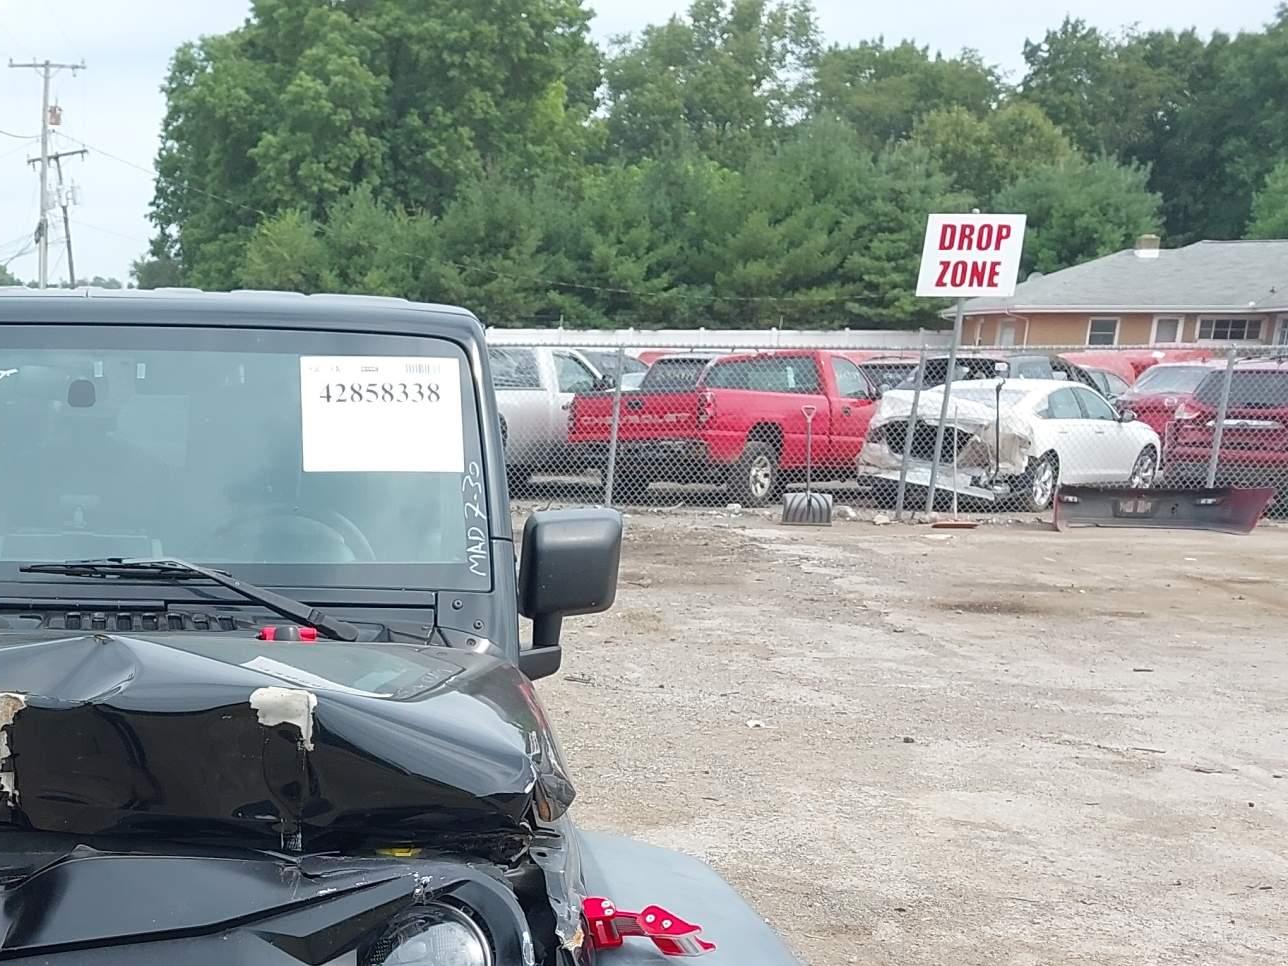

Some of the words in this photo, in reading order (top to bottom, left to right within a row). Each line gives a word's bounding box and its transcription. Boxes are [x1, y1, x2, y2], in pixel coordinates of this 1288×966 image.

[938, 224, 1011, 251] DROP
[935, 260, 1002, 287] ZONE
[319, 383, 441, 403] 42858338
[466, 526, 488, 577] MAD
